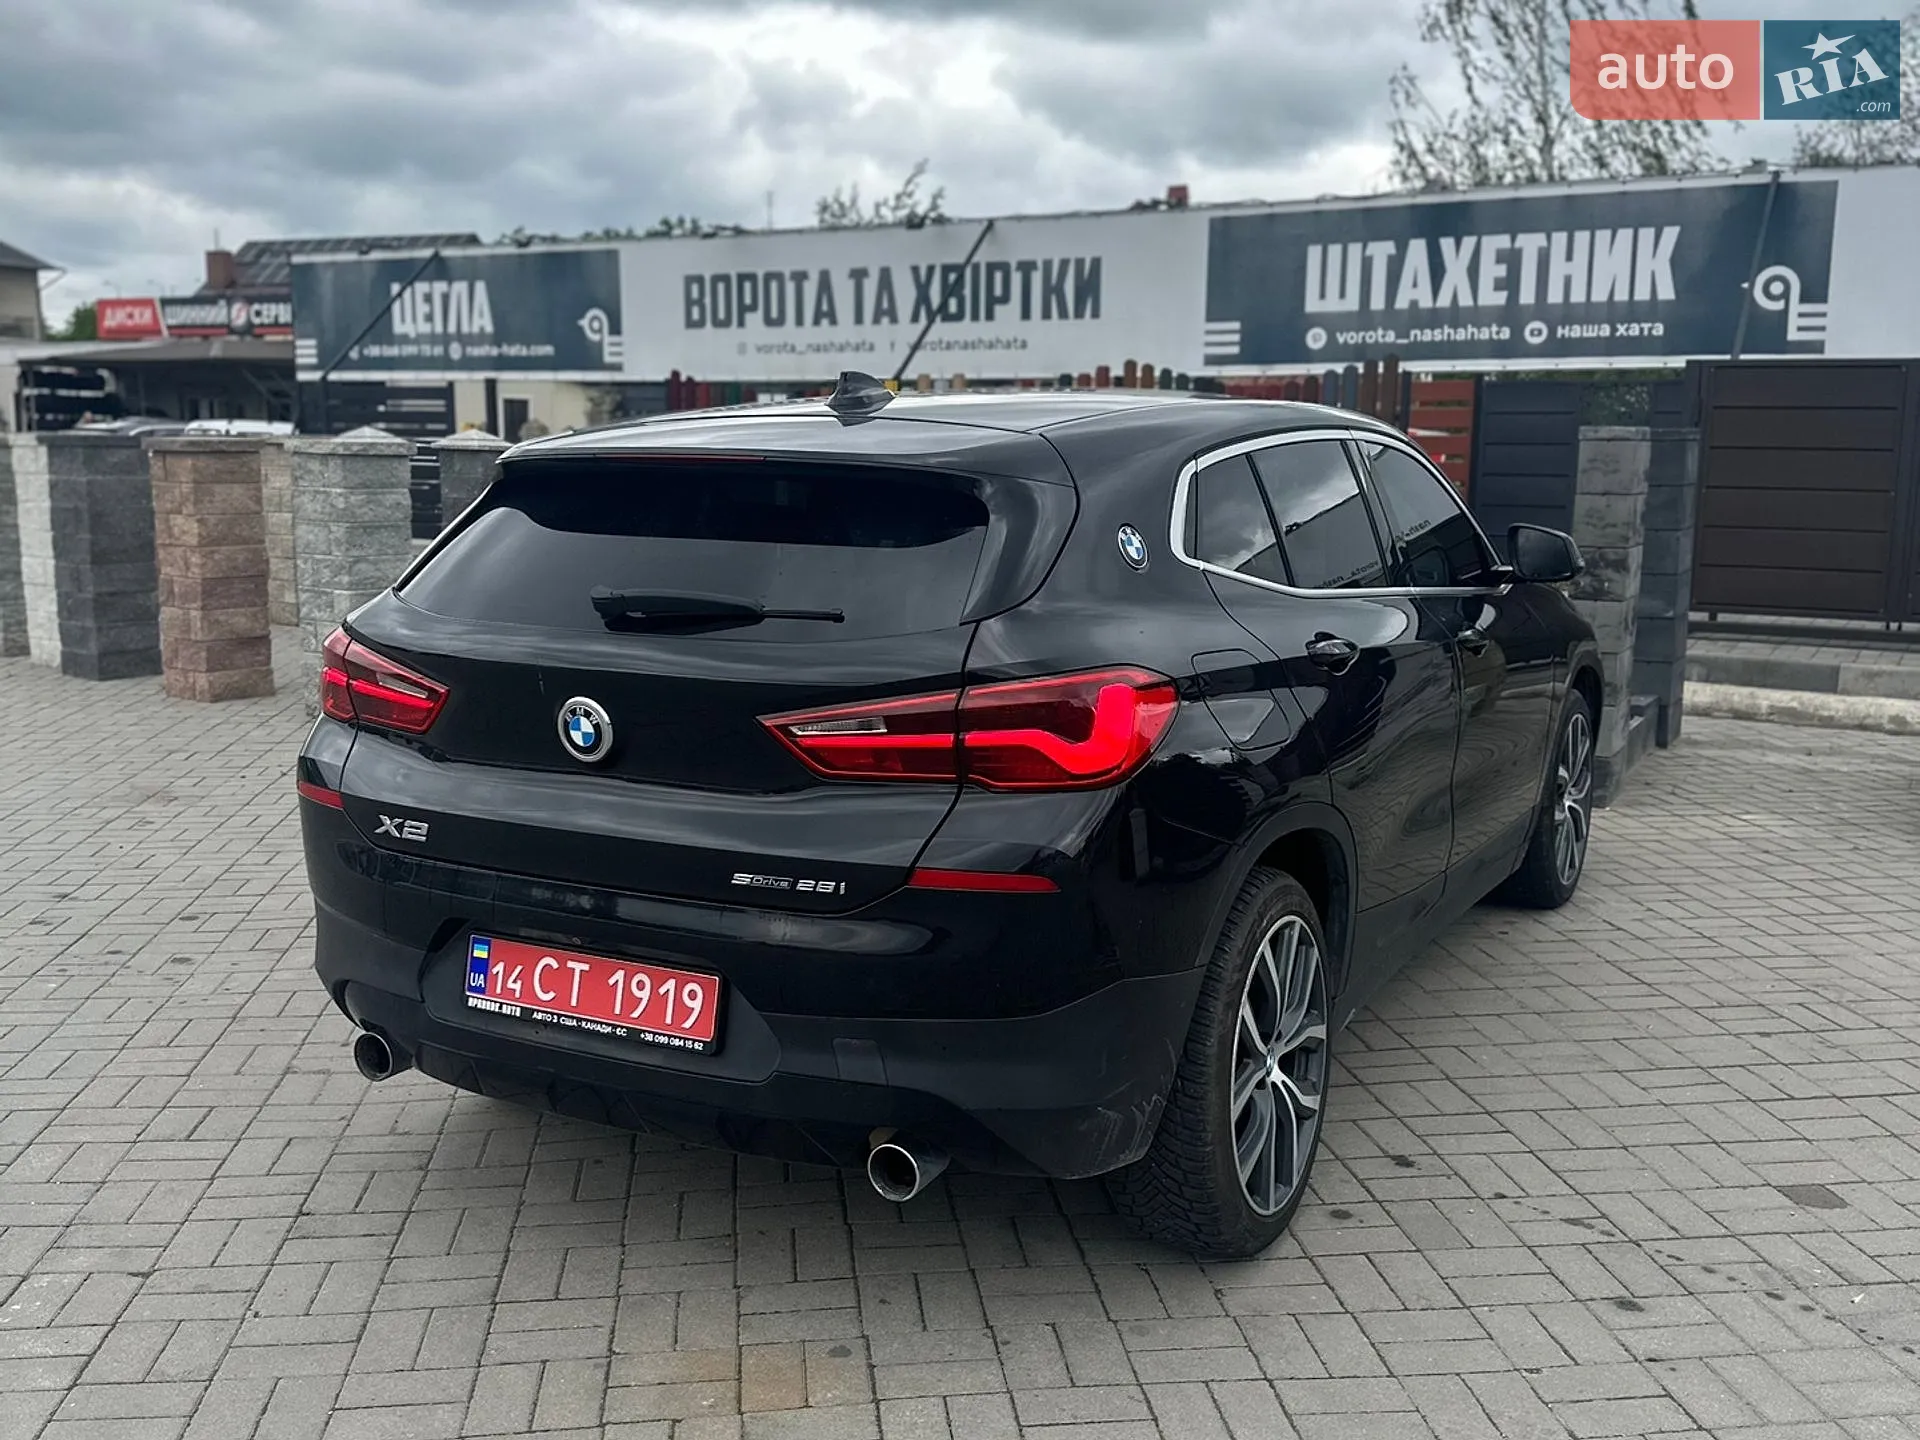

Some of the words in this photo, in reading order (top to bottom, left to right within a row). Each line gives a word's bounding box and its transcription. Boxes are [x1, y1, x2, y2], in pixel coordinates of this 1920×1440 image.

[1304, 225, 1681, 314] ШТАХЕТНИК
[390, 280, 494, 338] ЦЕГЛА
[684, 269, 837, 330] ВОРОТА
[848, 266, 899, 326] ТА
[909, 256, 1102, 324] ХВІРТКИ
[1336, 324, 1511, 345] vorota_nashahata
[1556, 322, 1610, 339] наша
[1616, 321, 1664, 337] хата
[373, 814, 429, 842] X2
[470, 972, 485, 988] UA
[491, 961, 524, 998] 14
[607, 969, 704, 1029] 1919
